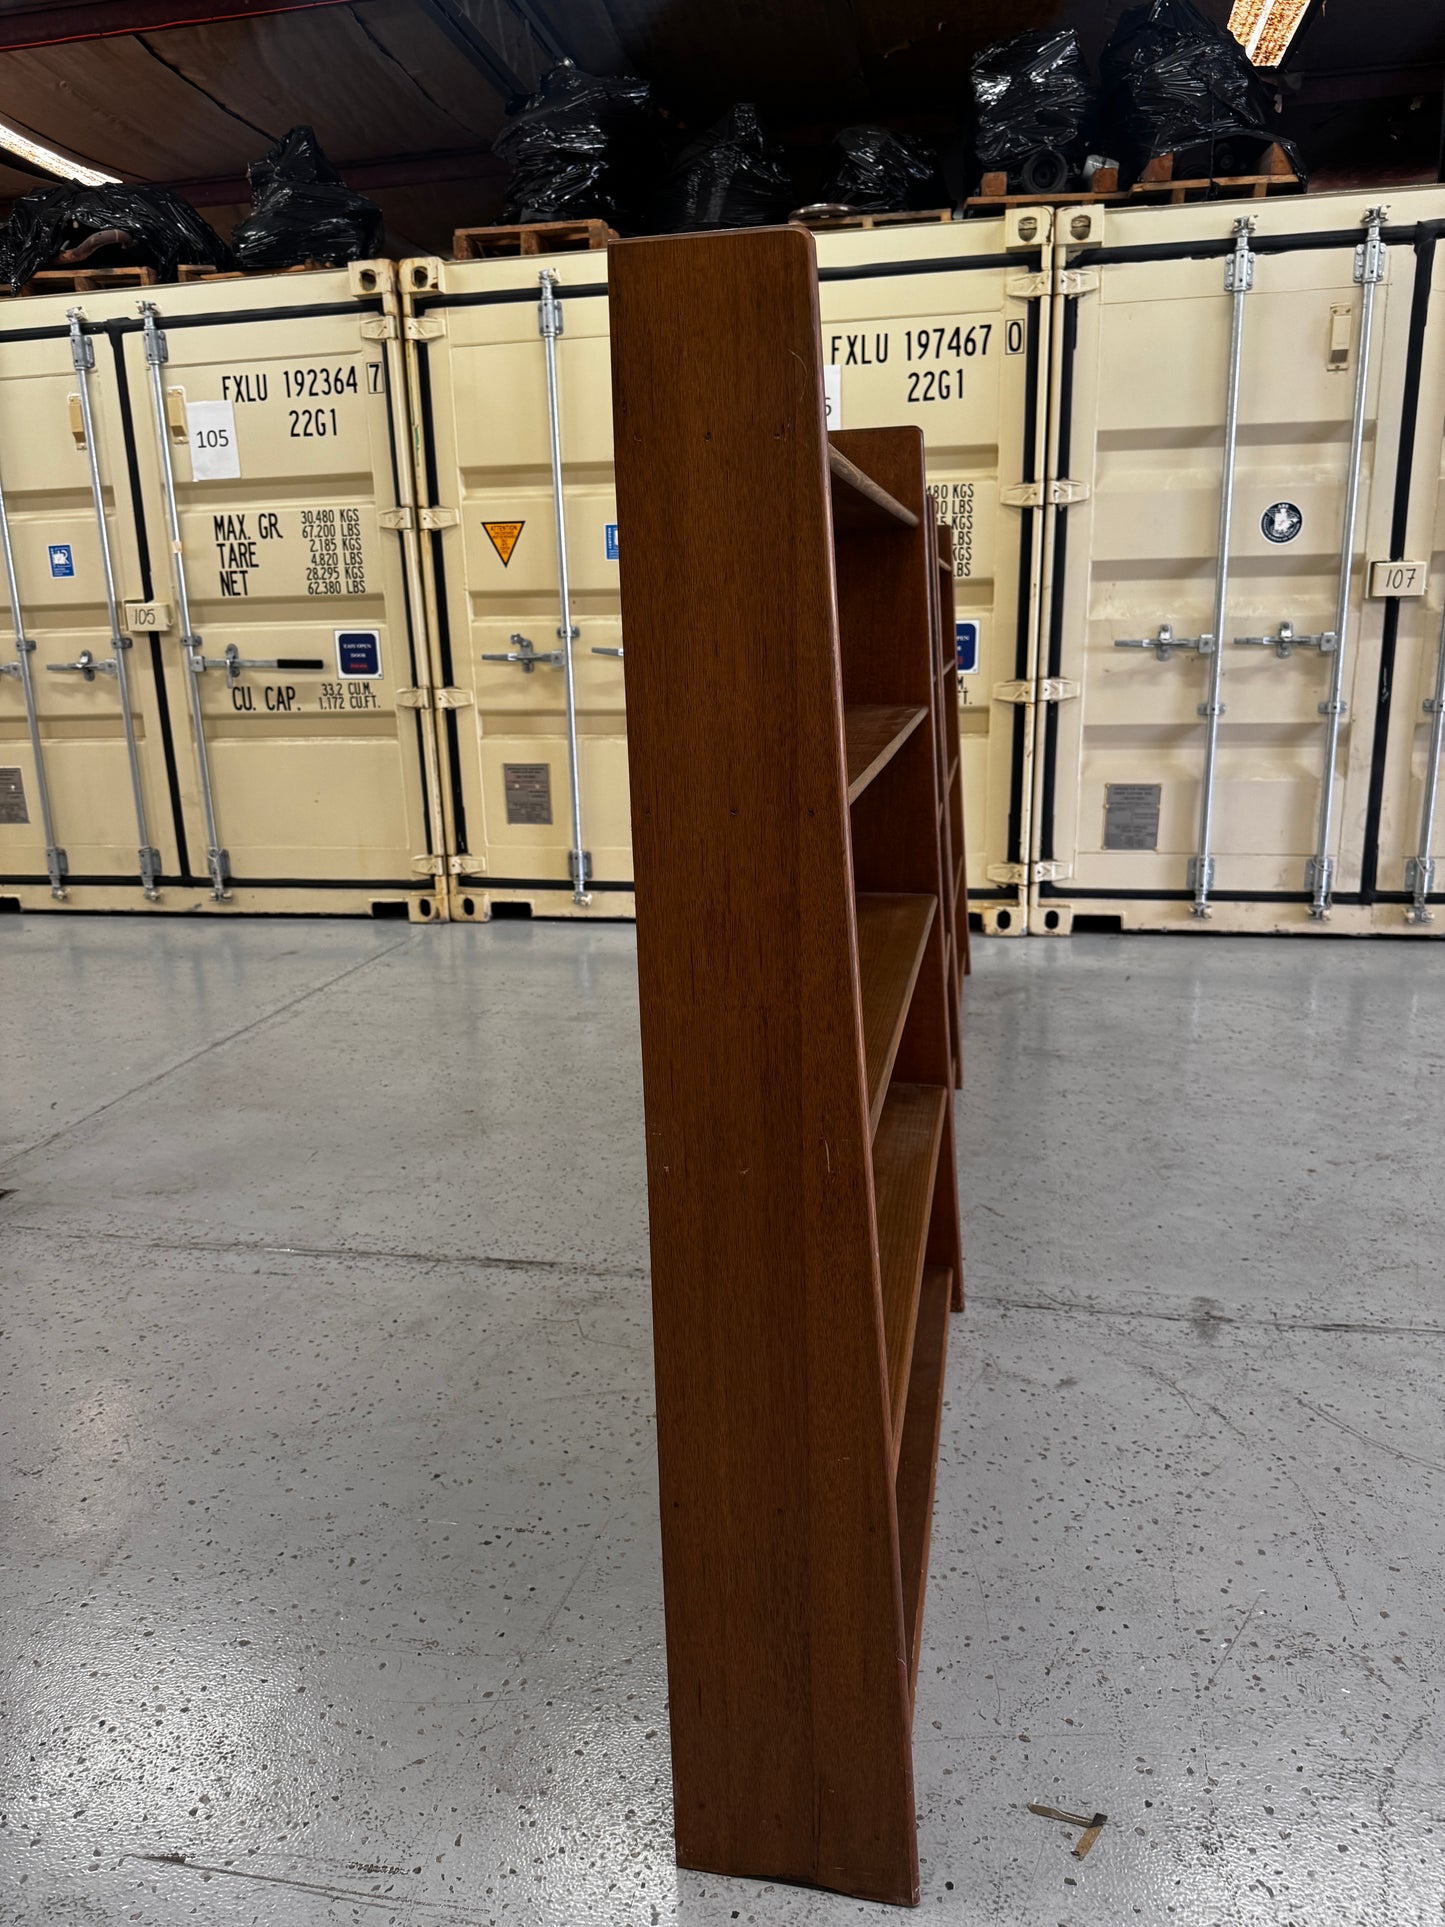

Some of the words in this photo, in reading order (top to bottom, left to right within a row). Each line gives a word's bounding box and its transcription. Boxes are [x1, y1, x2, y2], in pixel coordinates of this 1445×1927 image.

[831, 333, 888, 366] FXLU
[905, 324, 992, 361] 197467
[1008, 321, 1022, 352] 0
[222, 373, 268, 403] FXLU
[283, 365, 358, 398] 192364
[368, 364, 380, 392] 7
[907, 368, 964, 402] 22G1
[288, 408, 338, 438] 22G1
[196, 429, 229, 449] 105
[952, 484, 974, 499] KGS
[952, 499, 973, 514] LBS
[300, 510, 335, 524] 30.480
[340, 508, 360, 523] KGS
[952, 515, 973, 530] KGS
[214, 514, 251, 542] MAX.
[302, 524, 336, 538] 67.200
[340, 523, 361, 537] LBS
[342, 537, 362, 552] KGS
[216, 542, 260, 570] TARE
[343, 552, 364, 566] LBS
[306, 566, 340, 581] 28.295
[345, 566, 365, 580] KGS
[953, 562, 971, 577] BS
[219, 570, 248, 597] NET
[1386, 568, 1416, 589] 107
[308, 581, 342, 595] 62.380
[346, 580, 366, 594] LBS
[134, 608, 156, 625] 105
[232, 686, 256, 711] CU.
[318, 696, 345, 710] 1.172
